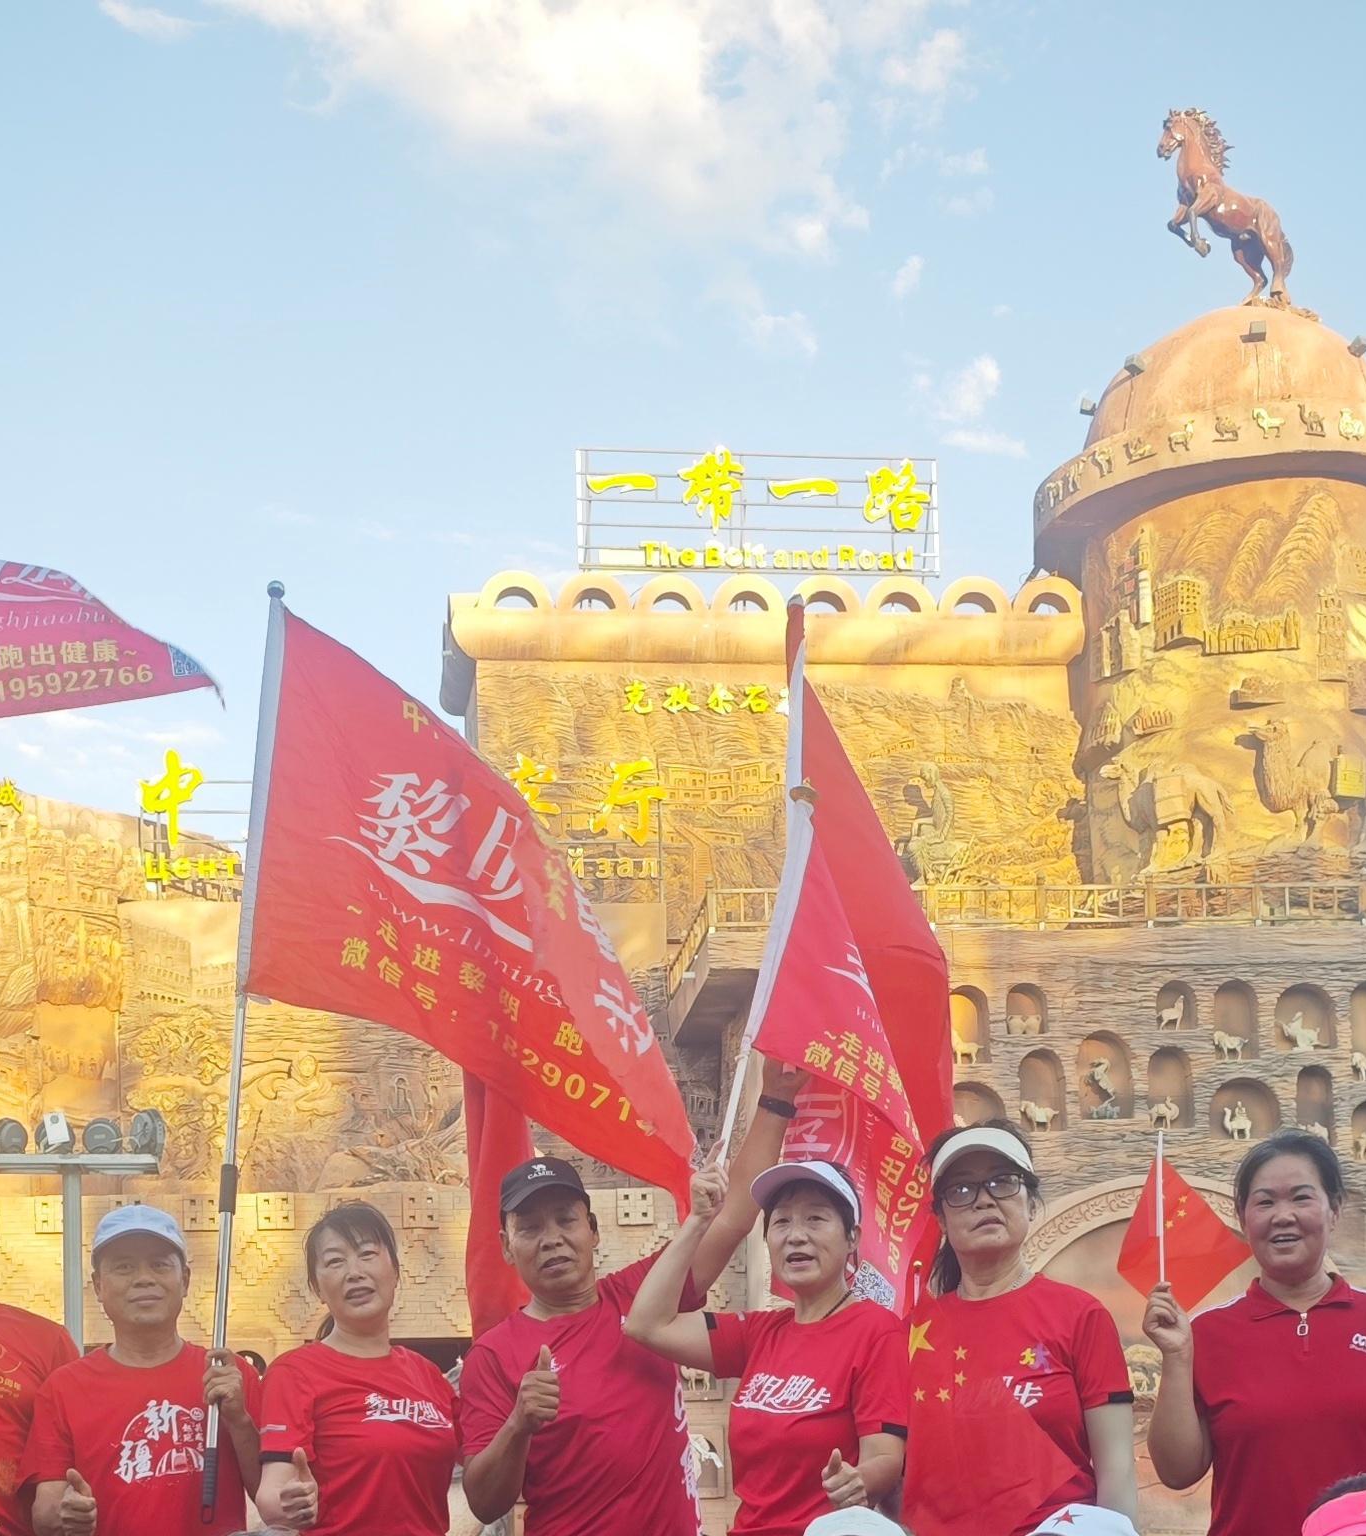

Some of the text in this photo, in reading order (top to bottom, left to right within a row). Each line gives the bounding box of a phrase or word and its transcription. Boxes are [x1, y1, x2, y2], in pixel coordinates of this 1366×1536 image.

[586, 445, 931, 534] 一带一路
[640, 540, 696, 568] The
[773, 545, 829, 570] and
[837, 544, 915, 571] Road
[144, 853, 240, 886] Цент
[595, 855, 658, 879] зал
[527, 1168, 557, 1181] CAMEL
